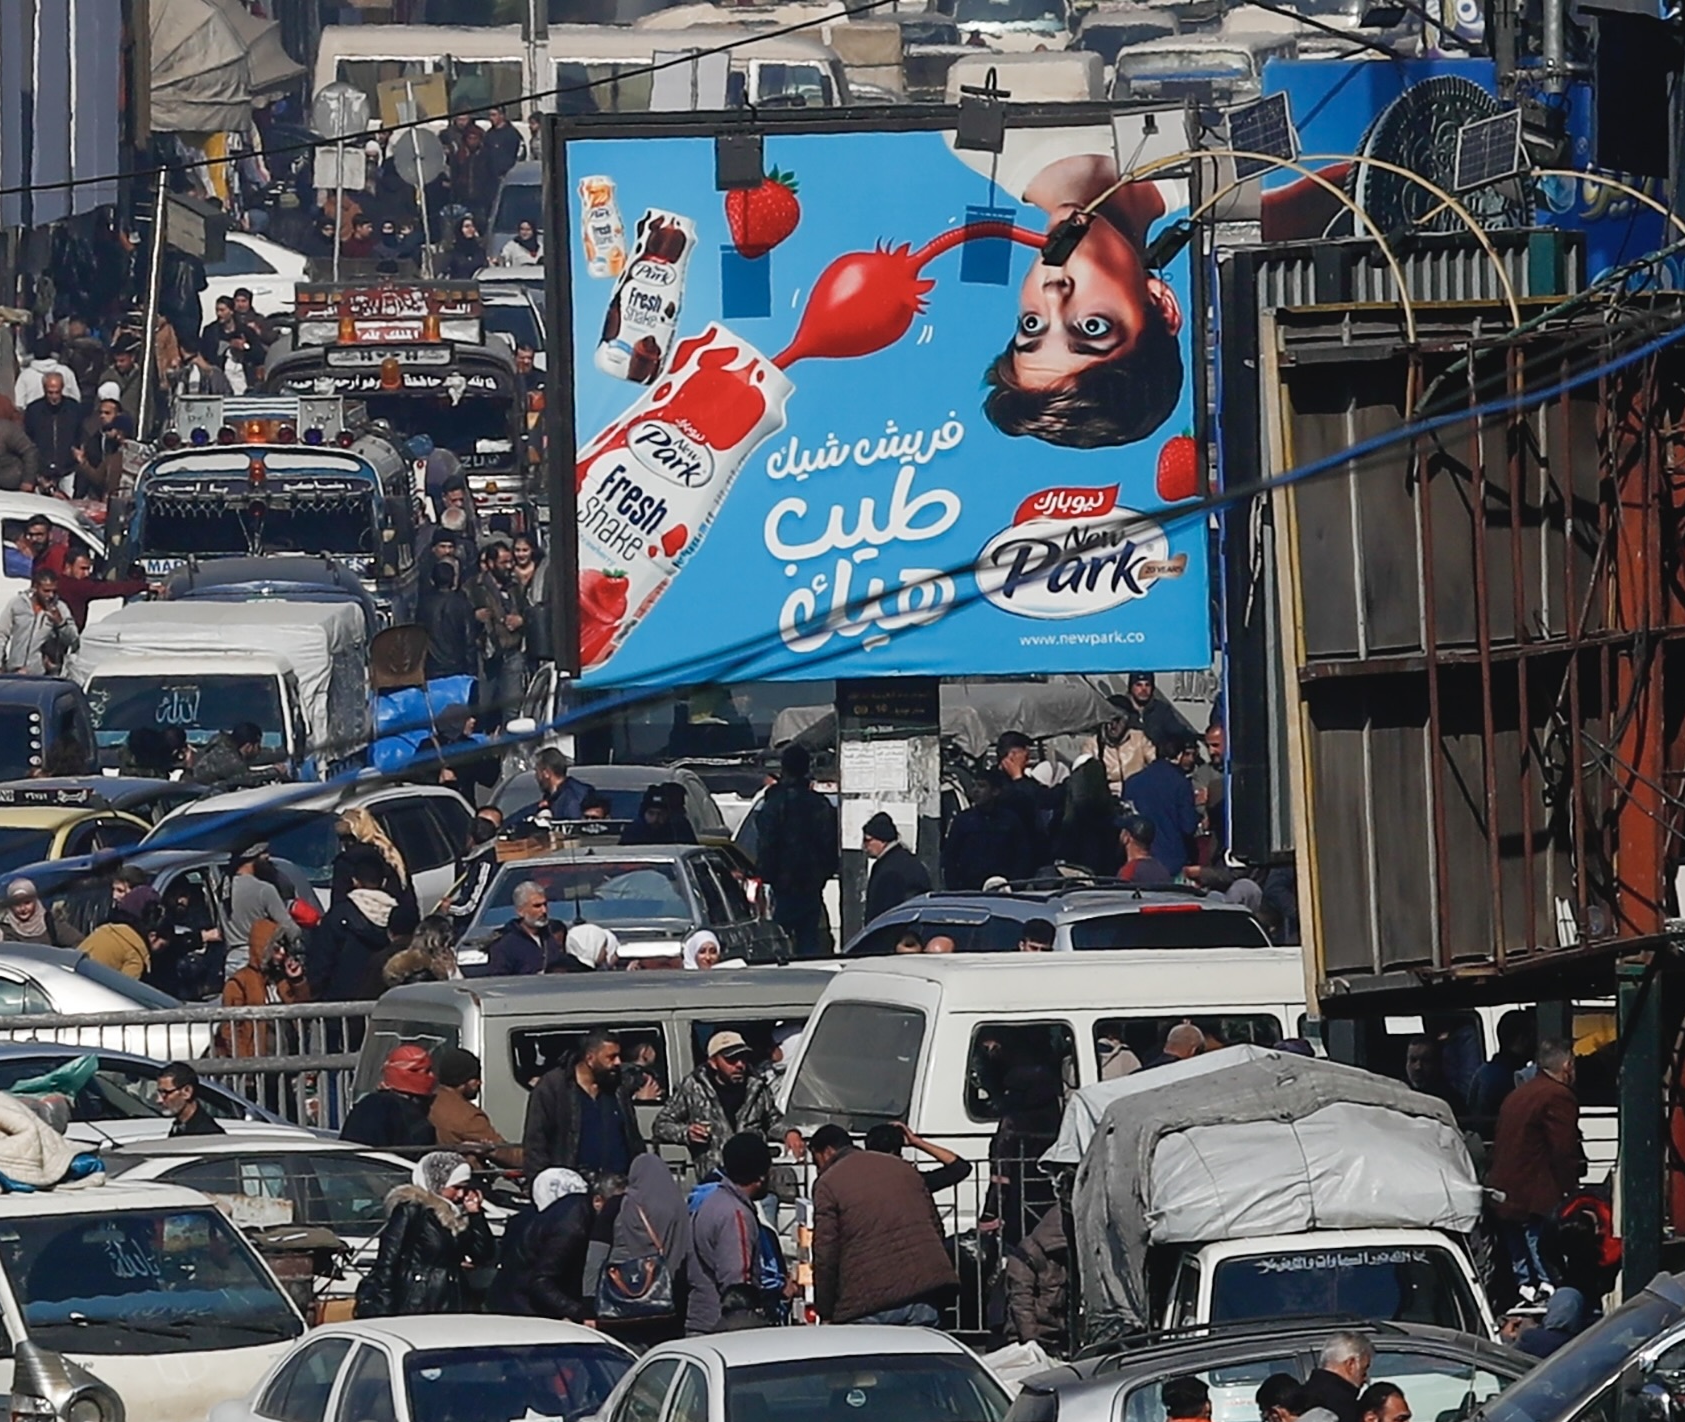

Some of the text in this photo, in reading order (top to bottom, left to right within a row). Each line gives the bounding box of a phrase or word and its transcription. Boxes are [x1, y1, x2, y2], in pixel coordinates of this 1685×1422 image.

[634, 423, 703, 487] Park
[766, 410, 965, 481] فريش شيك
[595, 464, 668, 536] Fresh
[764, 465, 963, 578] طيب
[1033, 490, 1105, 515] نيوبارك
[990, 537, 1148, 600] Park
[1064, 525, 1127, 551] New
[1019, 630, 1146, 647] www.newpark.co
